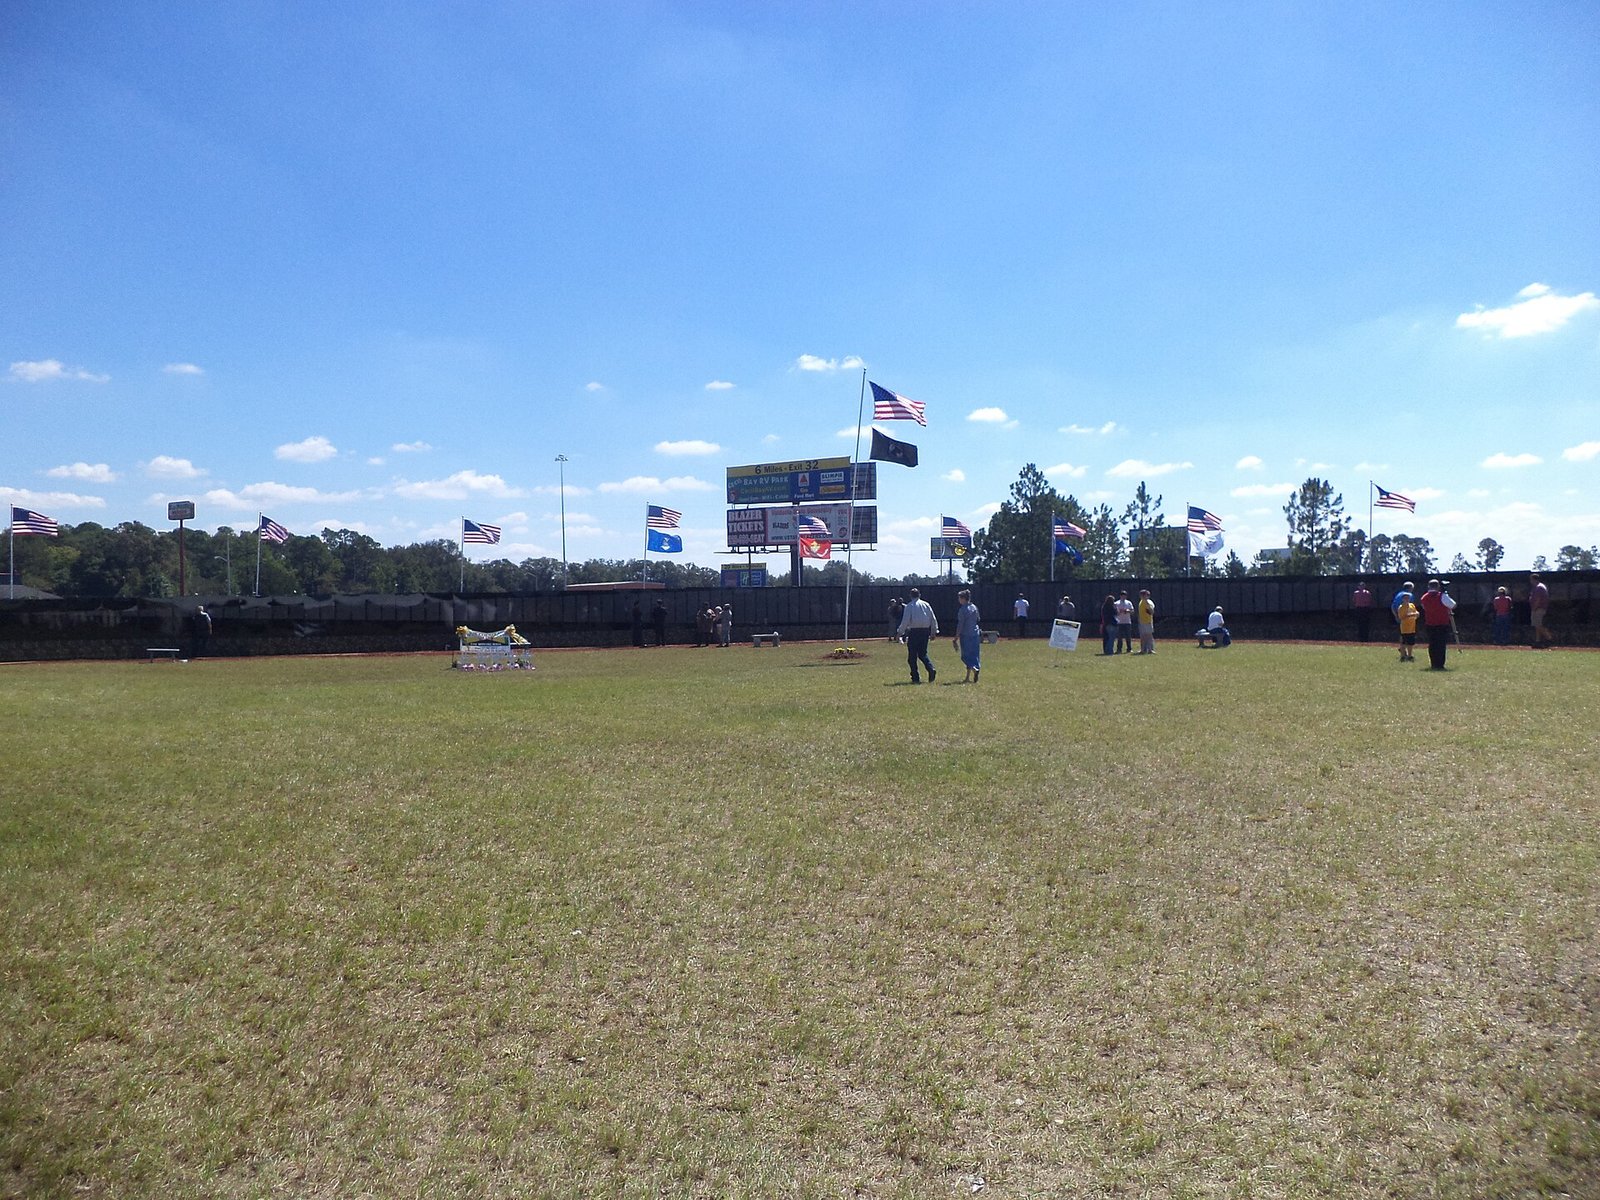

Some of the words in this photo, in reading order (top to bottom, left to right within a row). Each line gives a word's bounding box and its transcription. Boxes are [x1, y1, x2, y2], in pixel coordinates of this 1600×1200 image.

[755, 465, 762, 475] 6
[789, 463, 803, 471] Exit
[805, 460, 819, 470] 32
[759, 477, 770, 485] RV
[728, 510, 762, 521] BLAZER
[728, 521, 764, 532] TICKETS
